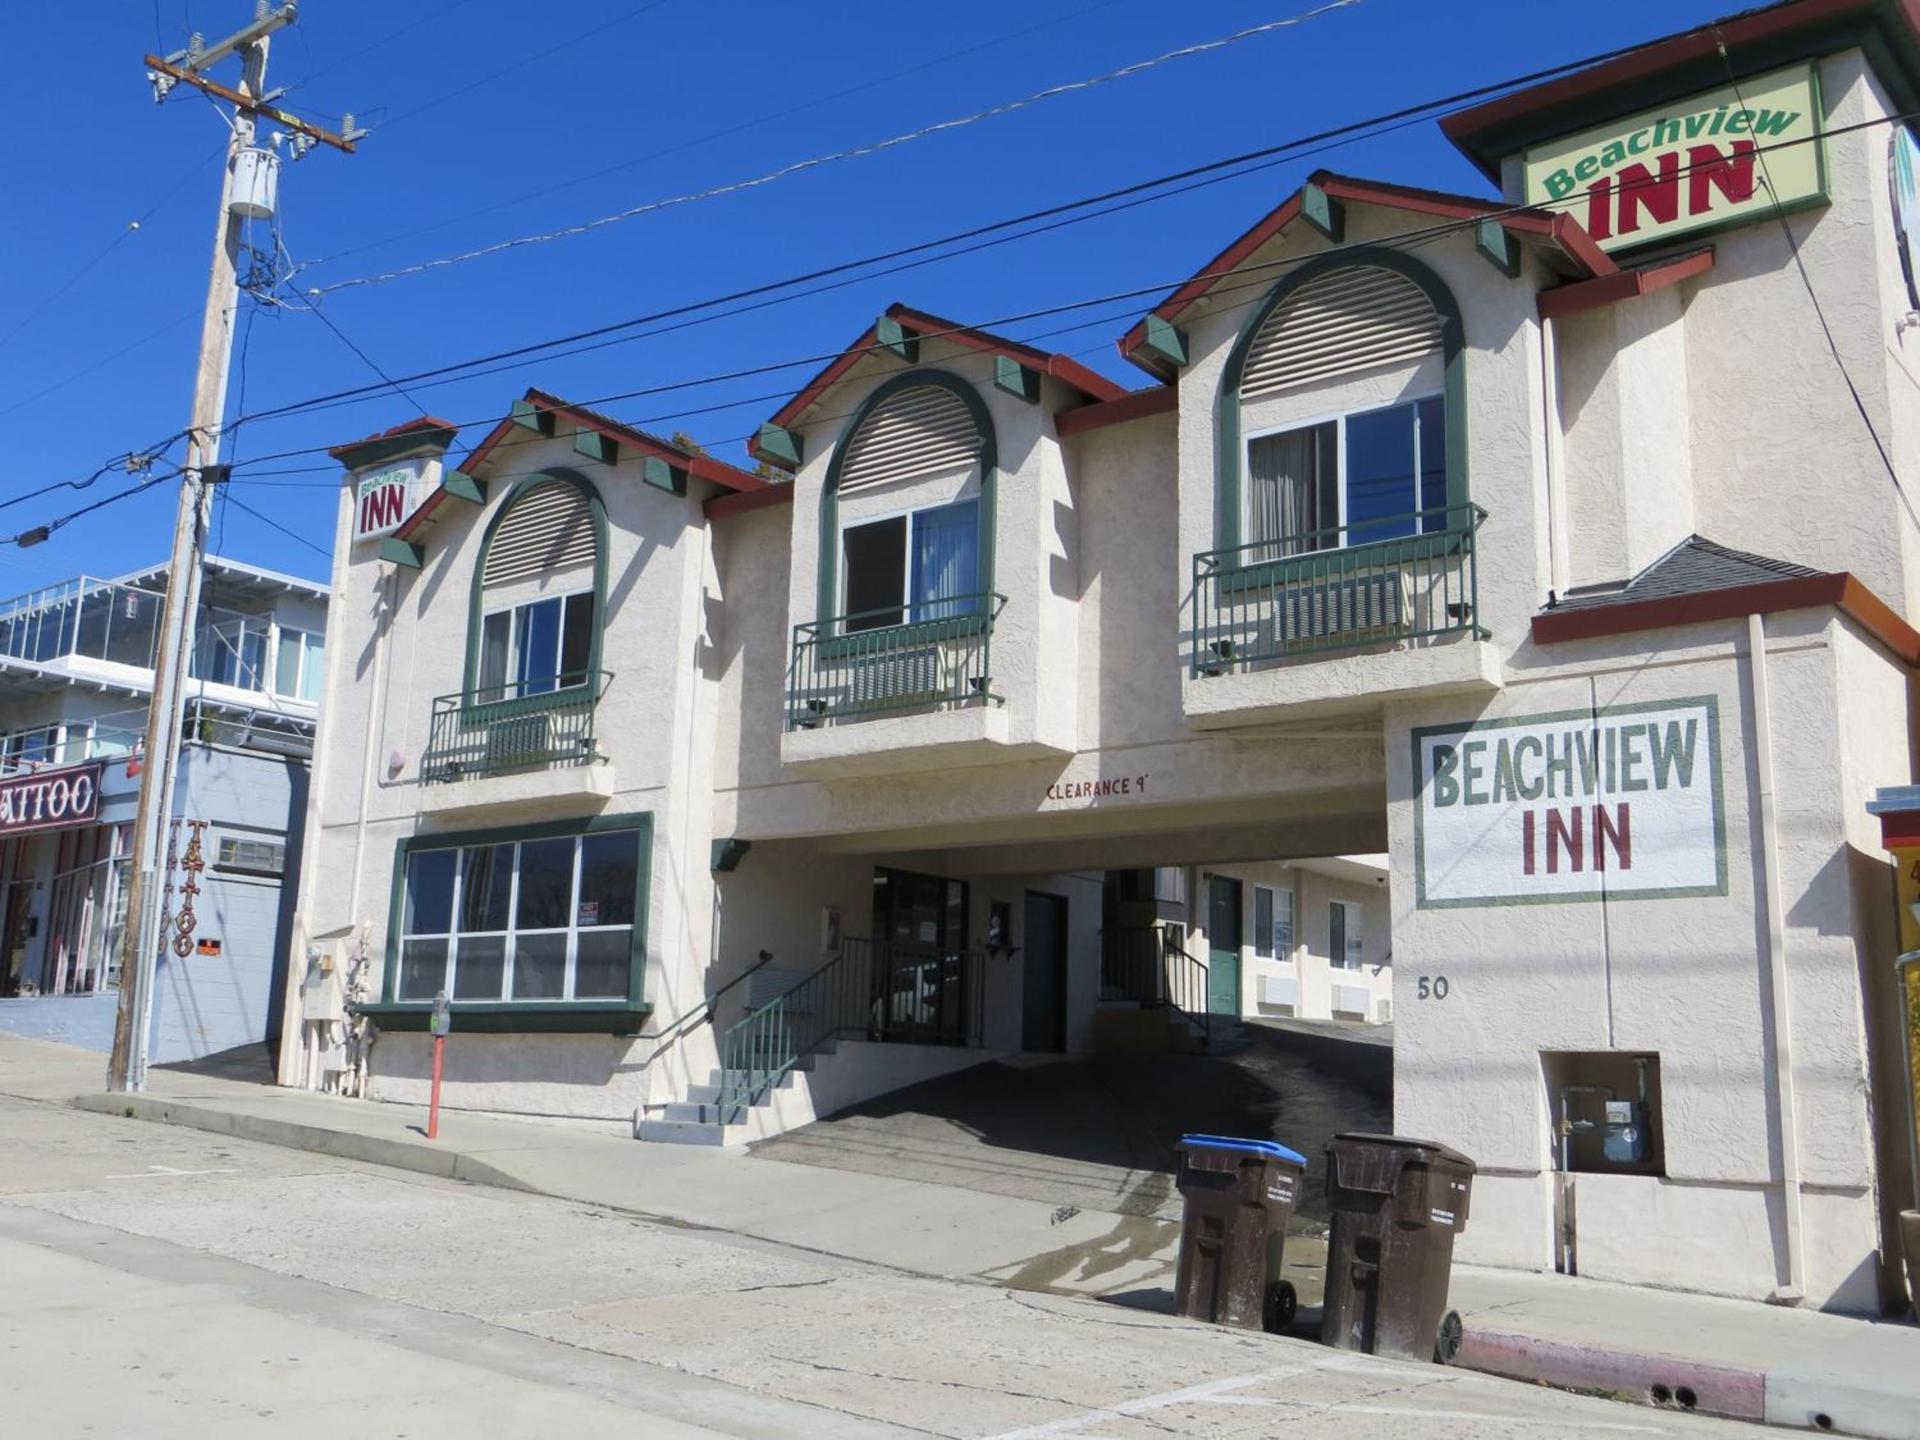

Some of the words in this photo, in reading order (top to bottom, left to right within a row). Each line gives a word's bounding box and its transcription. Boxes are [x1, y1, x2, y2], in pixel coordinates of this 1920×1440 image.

[1543, 105, 1800, 200] Beachview
[1588, 140, 1756, 241] INN
[360, 484, 406, 534] INN
[1046, 778, 1131, 800] CLEARANCE
[1433, 719, 1697, 808] BEACHVIEW
[1523, 802, 1632, 875] INN
[173, 819, 208, 957] TATTOO
[1417, 976, 1450, 1001] 50
